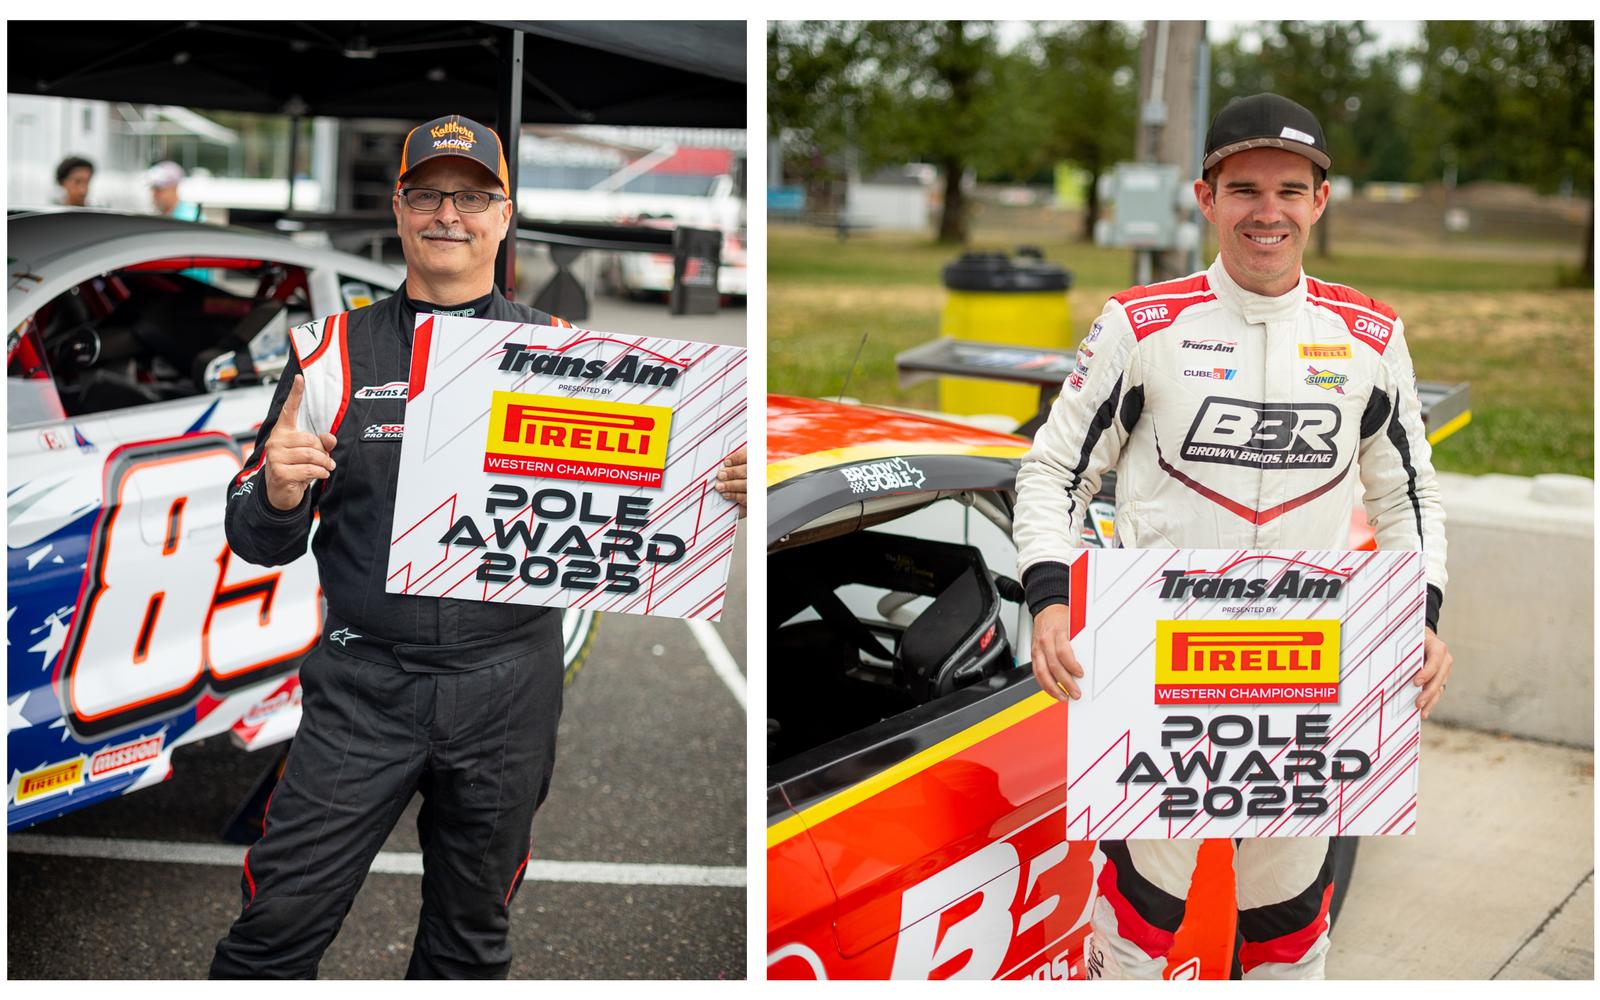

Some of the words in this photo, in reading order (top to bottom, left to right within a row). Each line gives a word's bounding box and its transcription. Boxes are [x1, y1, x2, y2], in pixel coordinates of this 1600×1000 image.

[431, 121, 476, 144] Kallberg
[432, 139, 473, 148] RACING
[1133, 305, 1169, 324] OMP
[1355, 319, 1389, 339] OMP
[1182, 340, 1213, 351] Trans
[1213, 343, 1234, 353] Am
[1303, 346, 1347, 357] PIRELLI
[498, 343, 606, 380] Trans
[607, 355, 679, 388] Am
[364, 389, 398, 397] Trans
[400, 387, 409, 397] A
[558, 384, 597, 394] PRESENTED
[599, 387, 613, 395] BY
[1308, 376, 1345, 384] SUNOCO
[502, 404, 655, 455] PIRELLI
[1190, 401, 1337, 451] B3R
[1186, 445, 1238, 459] BROWN
[1238, 451, 1283, 463] BROS.
[1285, 453, 1333, 464] RACING
[488, 457, 554, 473] WESTERN
[556, 463, 661, 483] CHAMPIONSHIP
[840, 461, 893, 481] BRODY
[864, 470, 914, 491] GOBLE
[485, 484, 654, 527] POLE
[438, 515, 686, 564] AWARD
[475, 552, 641, 593] 2025
[1159, 570, 1267, 599] Trans
[1266, 570, 1342, 599] Am
[1171, 631, 1324, 672] PIRELLI
[1158, 688, 1226, 700] WESTERN
[1229, 687, 1337, 699] CHAMPIONSHIP
[1160, 713, 1332, 747] POLE
[95, 740, 159, 771] mission
[1116, 750, 1371, 783] AWARD
[23, 763, 78, 794] PIRELLI
[1158, 785, 1329, 818] 2025
